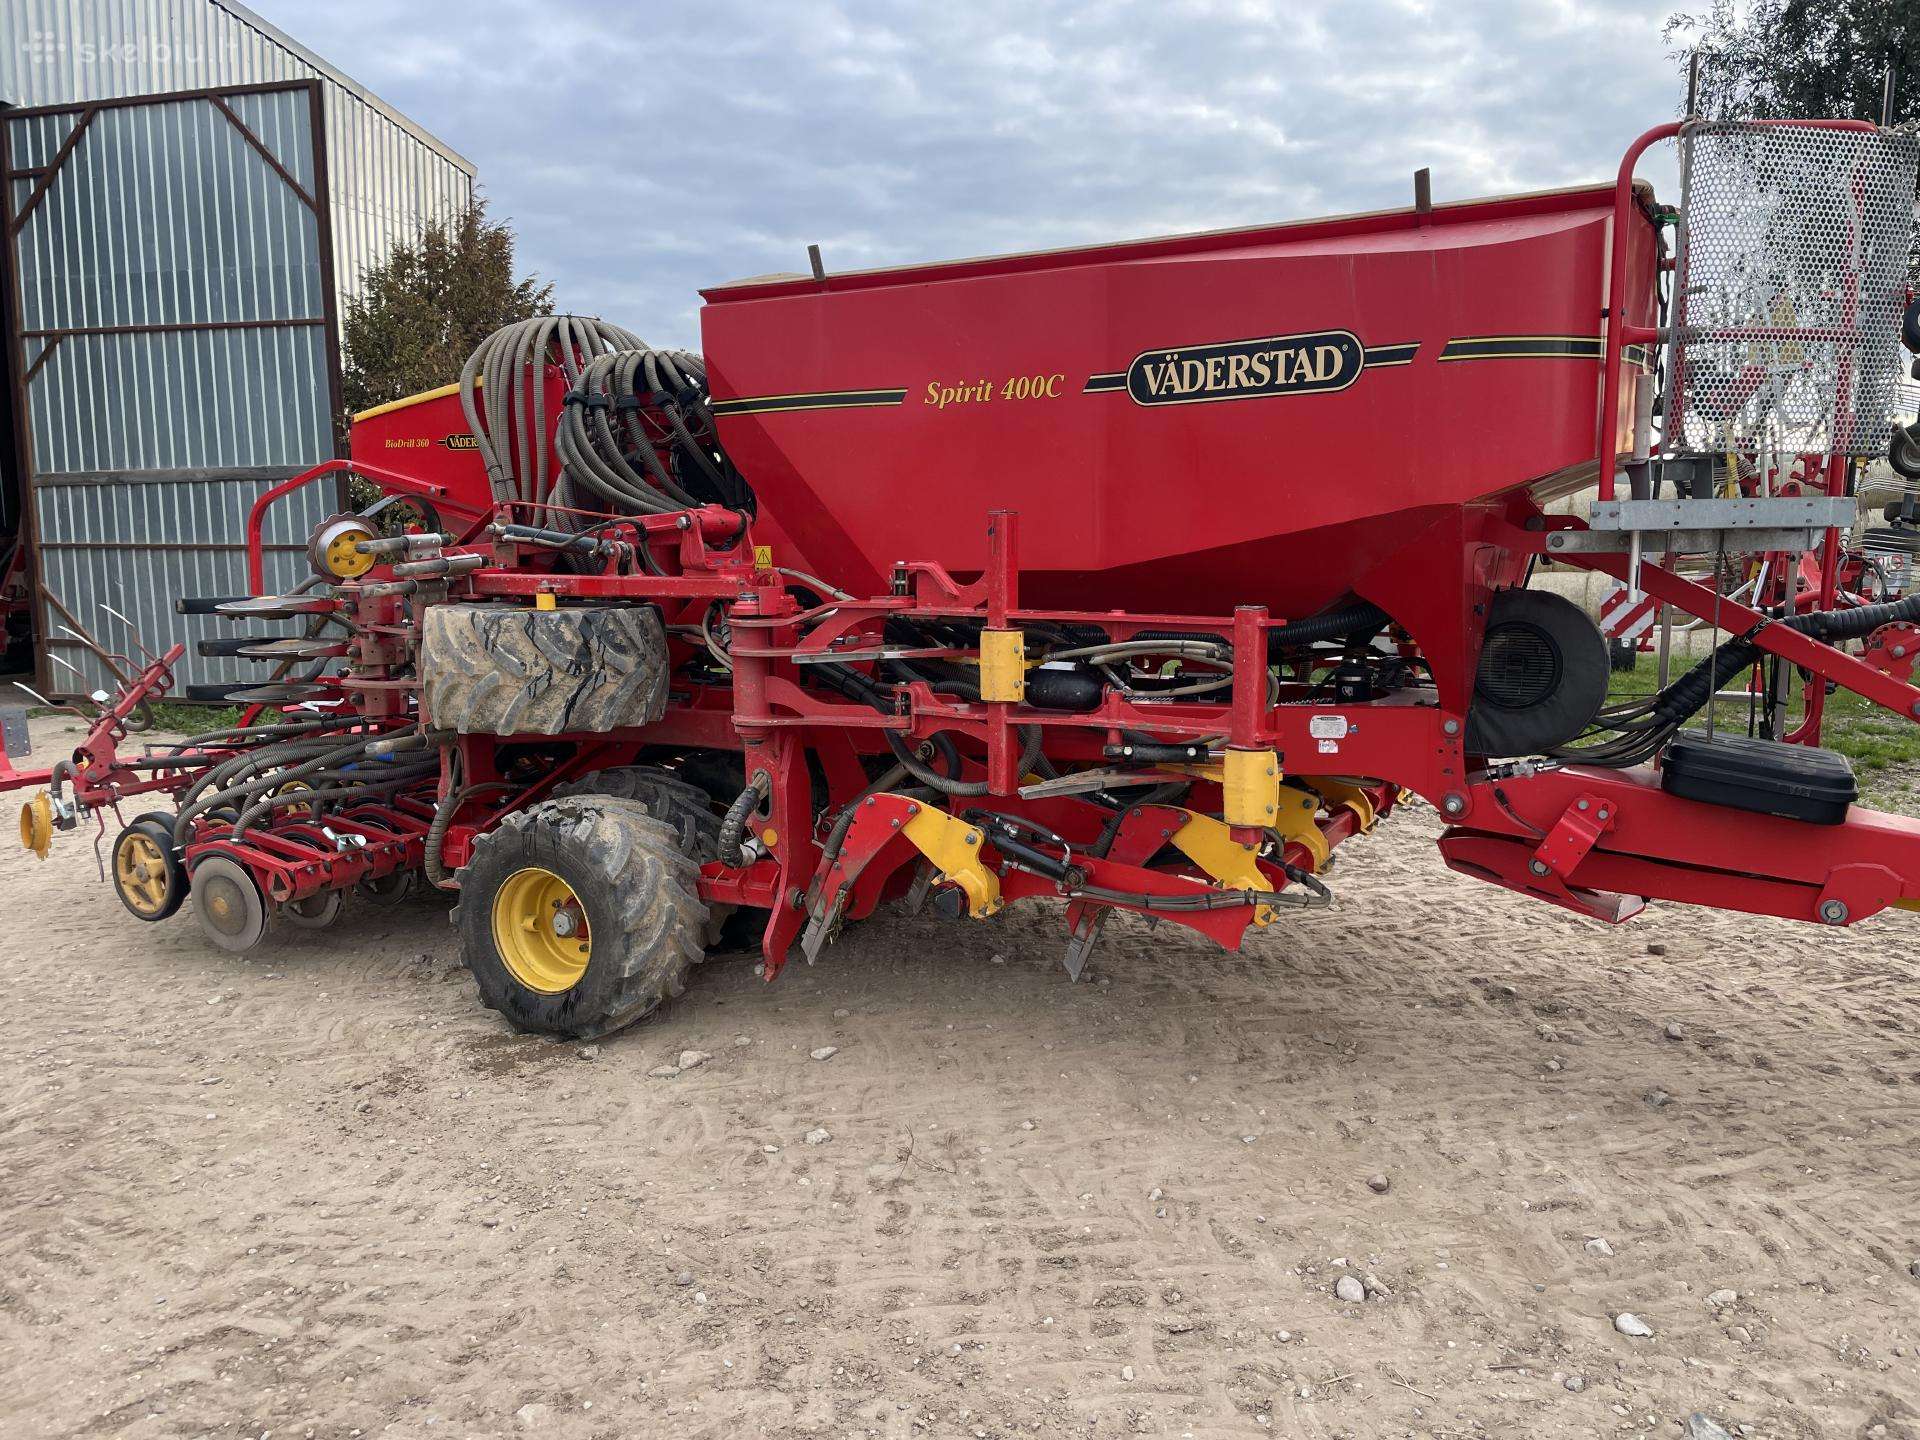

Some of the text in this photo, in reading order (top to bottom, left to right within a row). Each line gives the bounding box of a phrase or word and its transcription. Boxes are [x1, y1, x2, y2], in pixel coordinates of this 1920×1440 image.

[924, 374, 1065, 410] Spirit 400C
[385, 438, 430, 448] BioDrill 360
[449, 434, 479, 448] VÄDER
